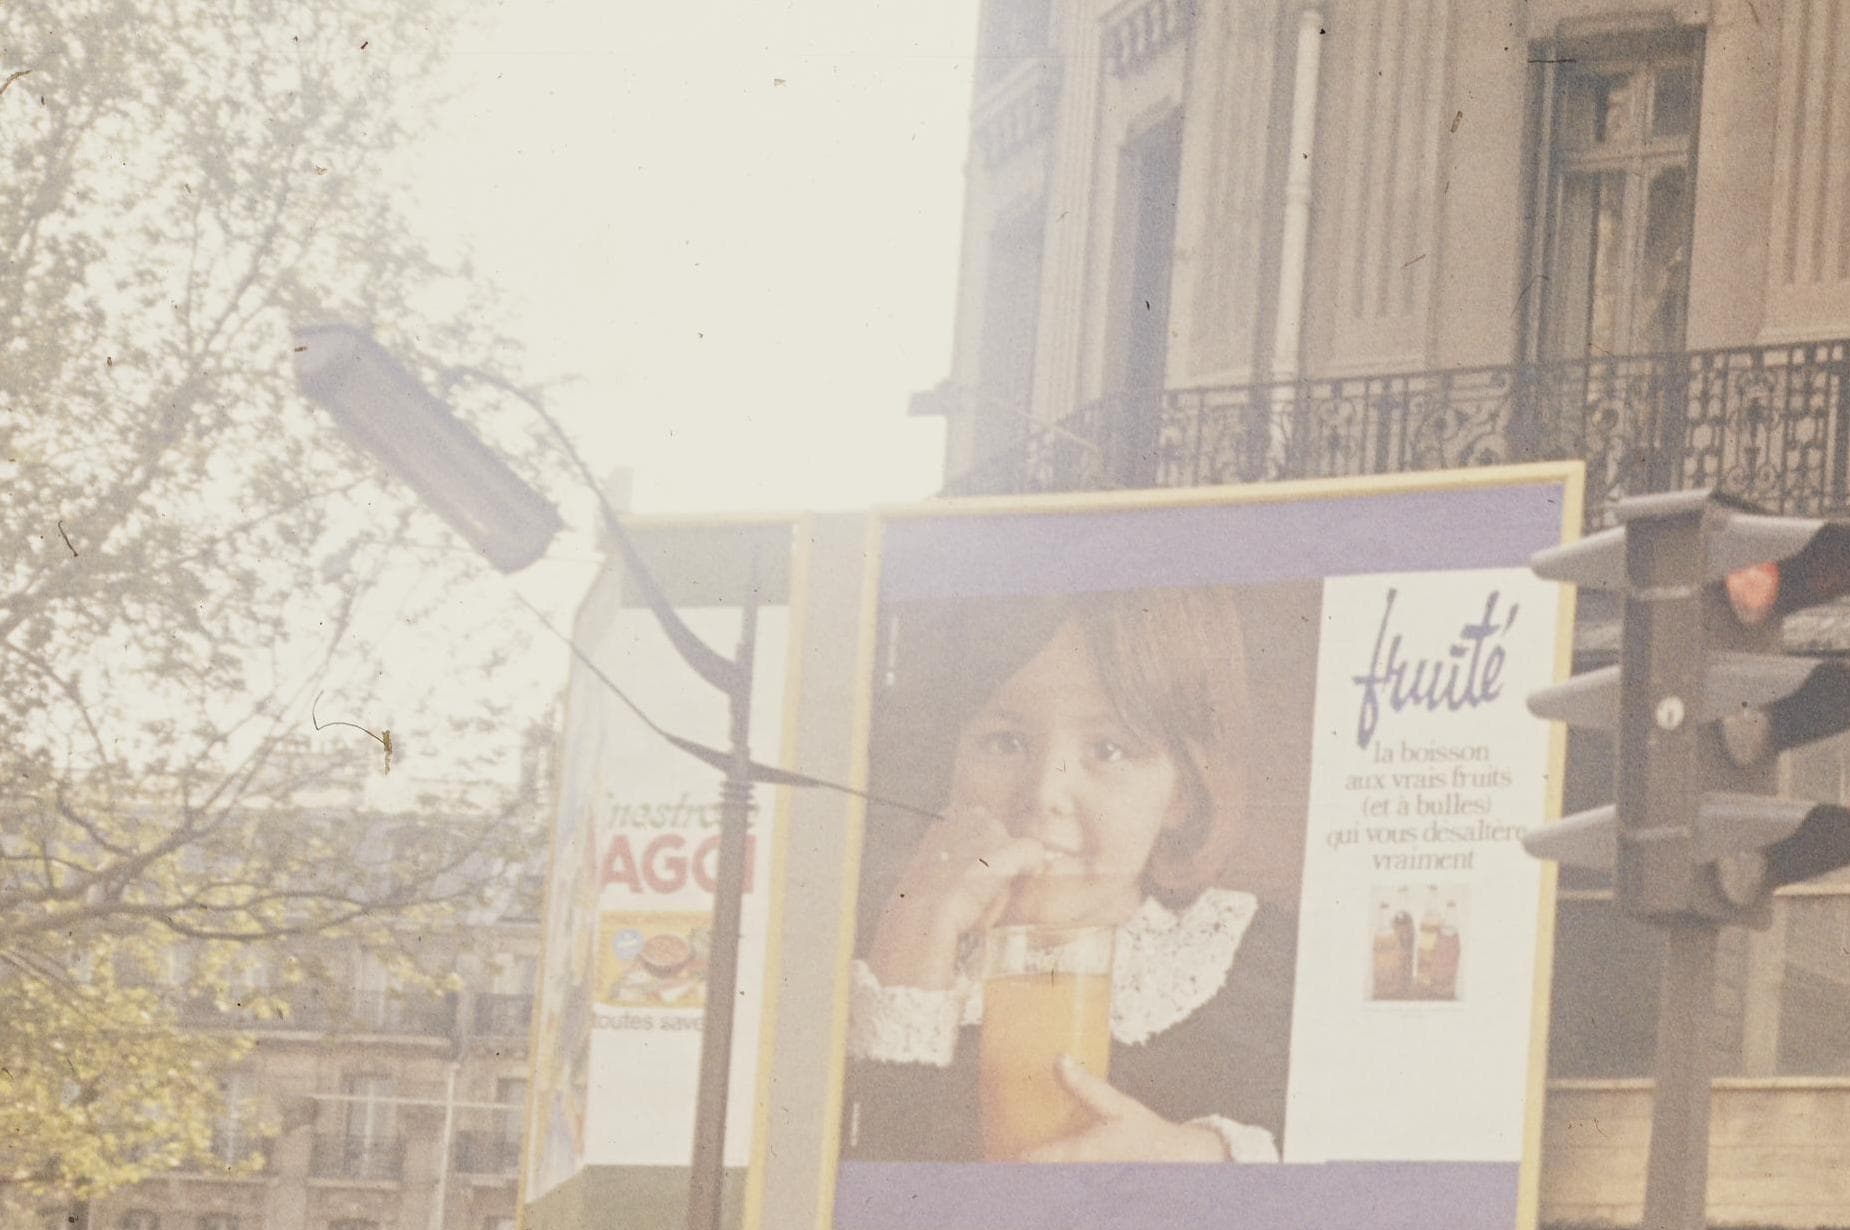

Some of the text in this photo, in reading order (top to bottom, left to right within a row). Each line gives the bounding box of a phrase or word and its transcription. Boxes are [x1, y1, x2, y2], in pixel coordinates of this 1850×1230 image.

[1373, 739, 1490, 764] la boisson
[1345, 765, 1512, 791] aux vrais fruits
[1326, 822, 1360, 850] qui
[1366, 826, 1418, 845] vous
[1372, 846, 1475, 870] vraiment
